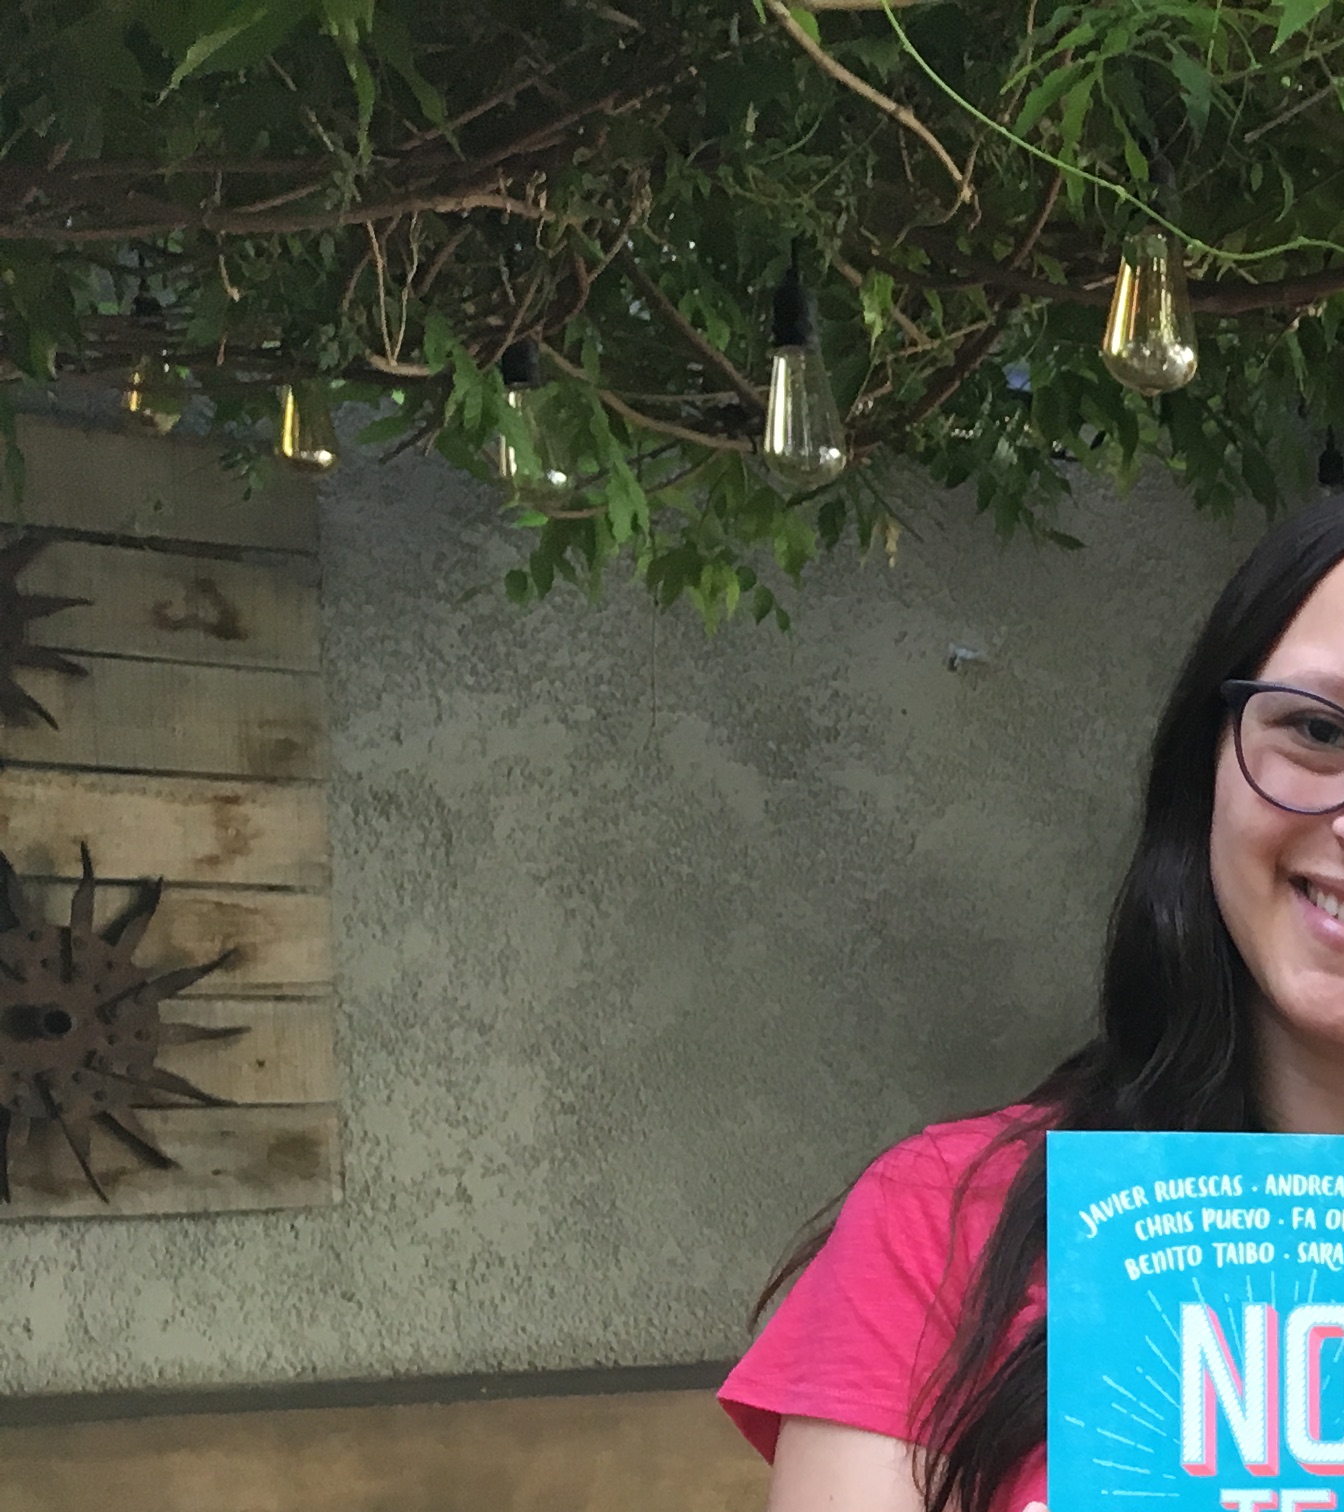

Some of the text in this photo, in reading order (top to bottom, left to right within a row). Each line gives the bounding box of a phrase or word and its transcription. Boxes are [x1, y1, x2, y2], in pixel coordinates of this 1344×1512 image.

[1079, 1185, 1149, 1239] JAVIER
[1154, 1174, 1243, 1203] RUESCAS
[1134, 1210, 1194, 1241] CHRIS
[1201, 1207, 1271, 1232] PUEYO
[1291, 1206, 1317, 1230] FA
[1124, 1244, 1203, 1281] BENITO
[1211, 1241, 1275, 1268] TAIBO
[1297, 1241, 1344, 1272] SARA
